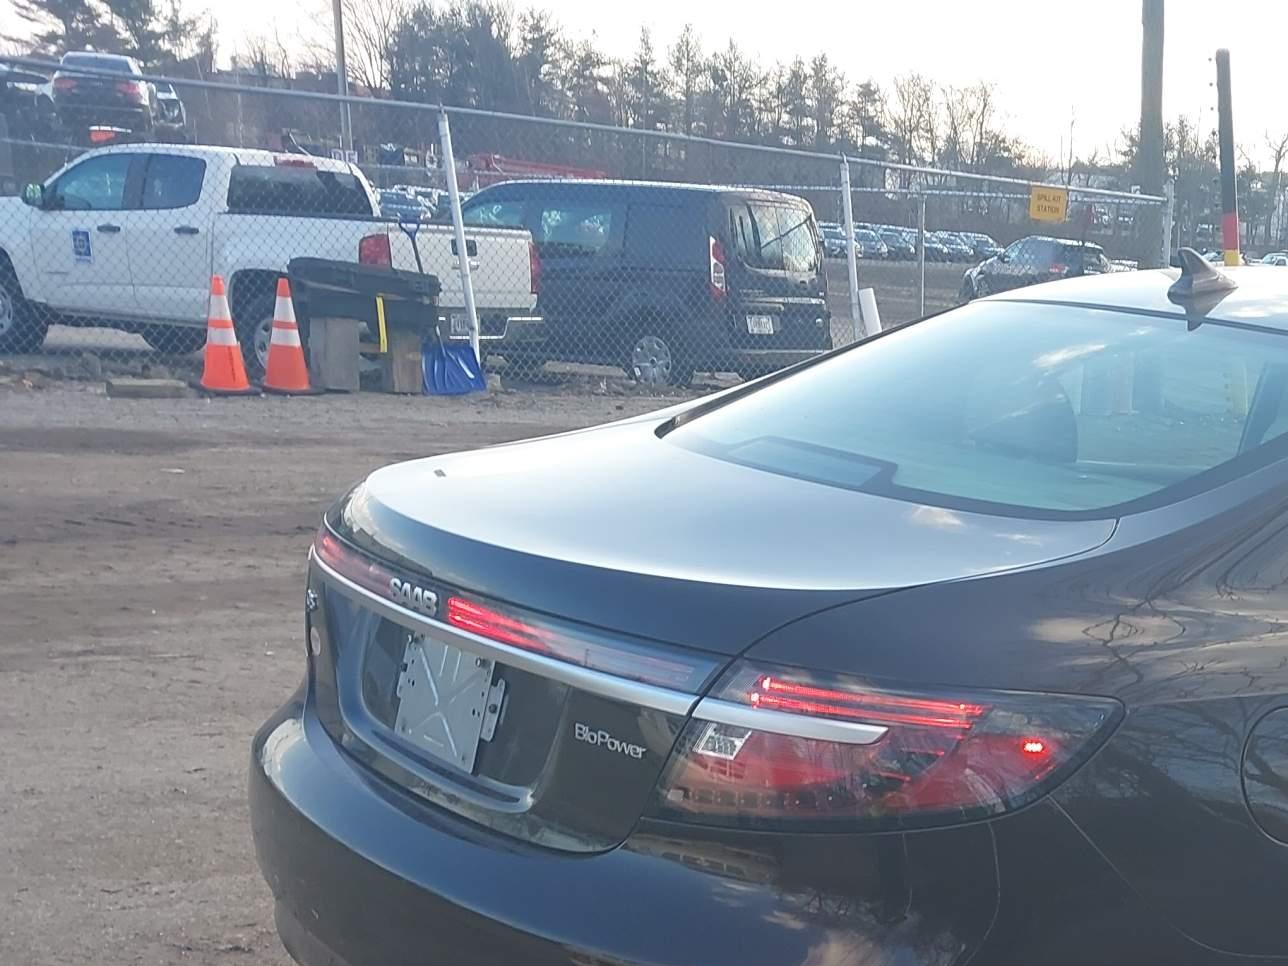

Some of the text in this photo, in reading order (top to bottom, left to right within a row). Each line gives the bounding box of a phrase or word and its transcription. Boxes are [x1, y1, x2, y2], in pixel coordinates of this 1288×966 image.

[1036, 205, 1060, 214] STATION
[390, 577, 438, 617] SAAB
[575, 722, 647, 759] BioPower
